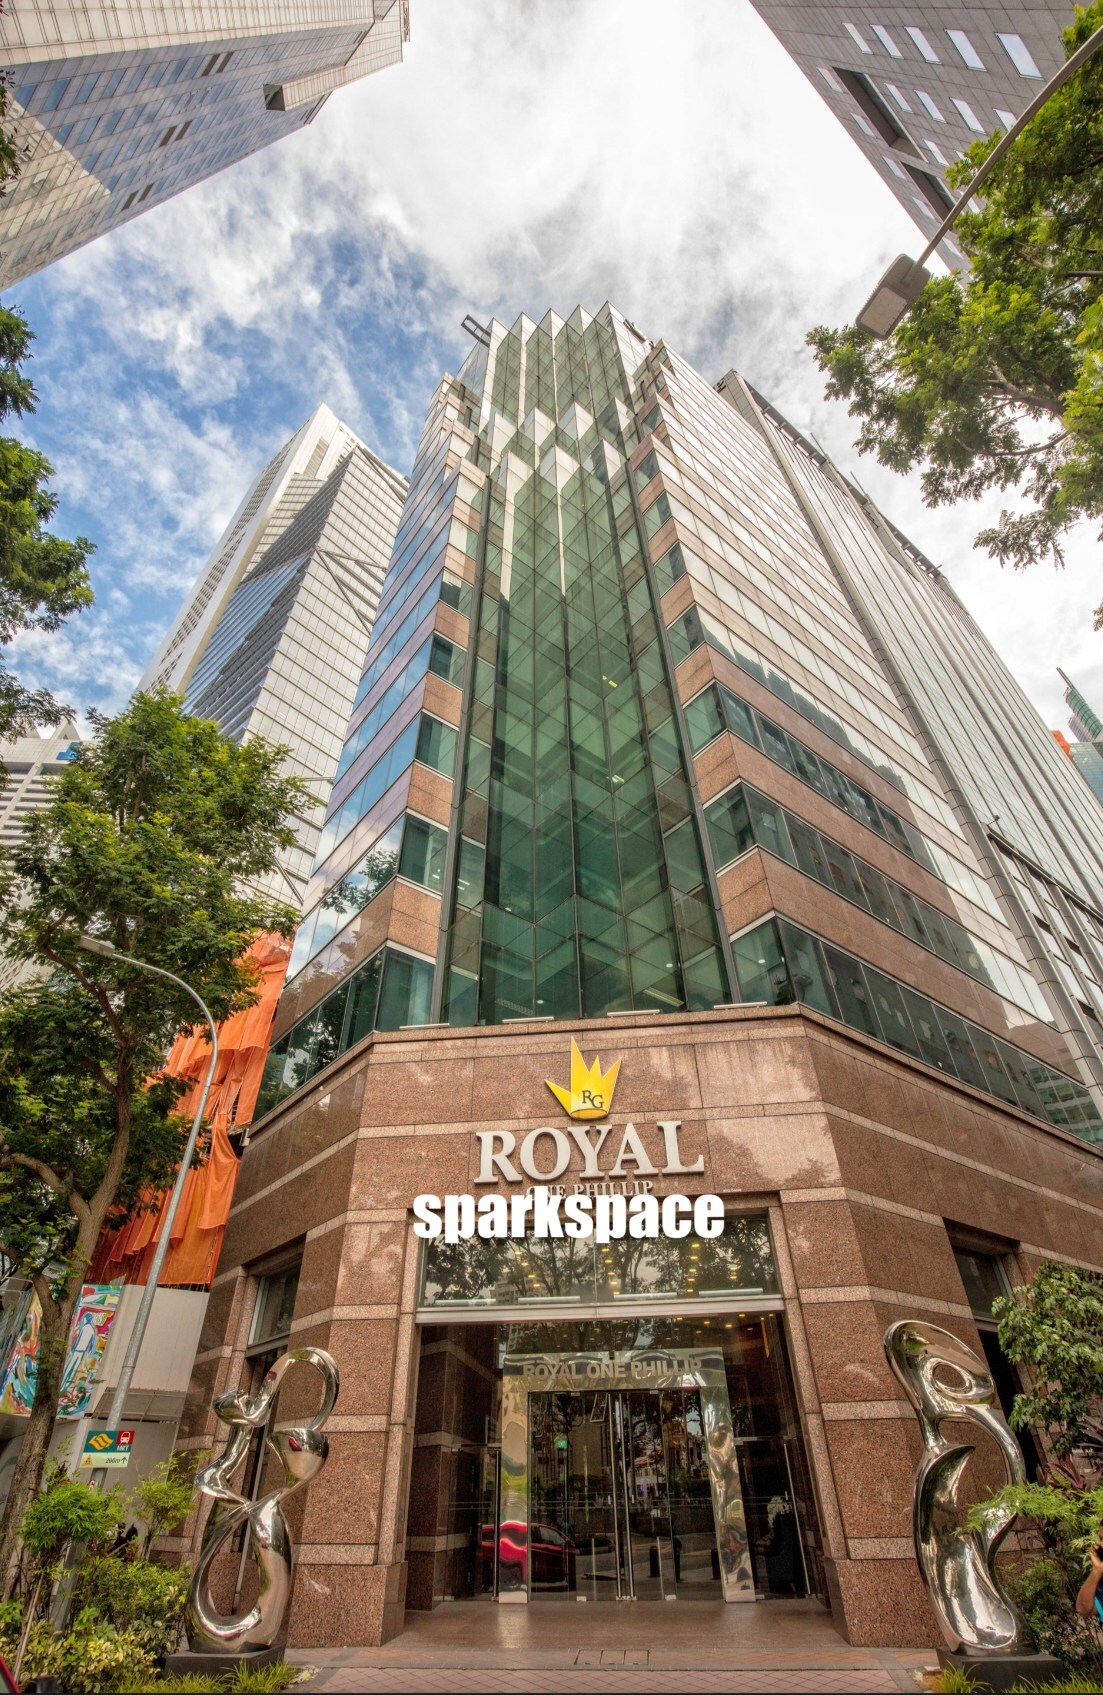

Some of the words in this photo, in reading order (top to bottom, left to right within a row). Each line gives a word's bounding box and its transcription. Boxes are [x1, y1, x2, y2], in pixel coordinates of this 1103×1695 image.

[582, 1090, 604, 1109] RG
[474, 1120, 705, 1184] ROYAL
[574, 1180, 654, 1199] PHILLIP
[523, 1363, 582, 1380] ROYAL
[586, 1361, 627, 1379] ONE
[630, 1360, 702, 1378] PHILLIP
